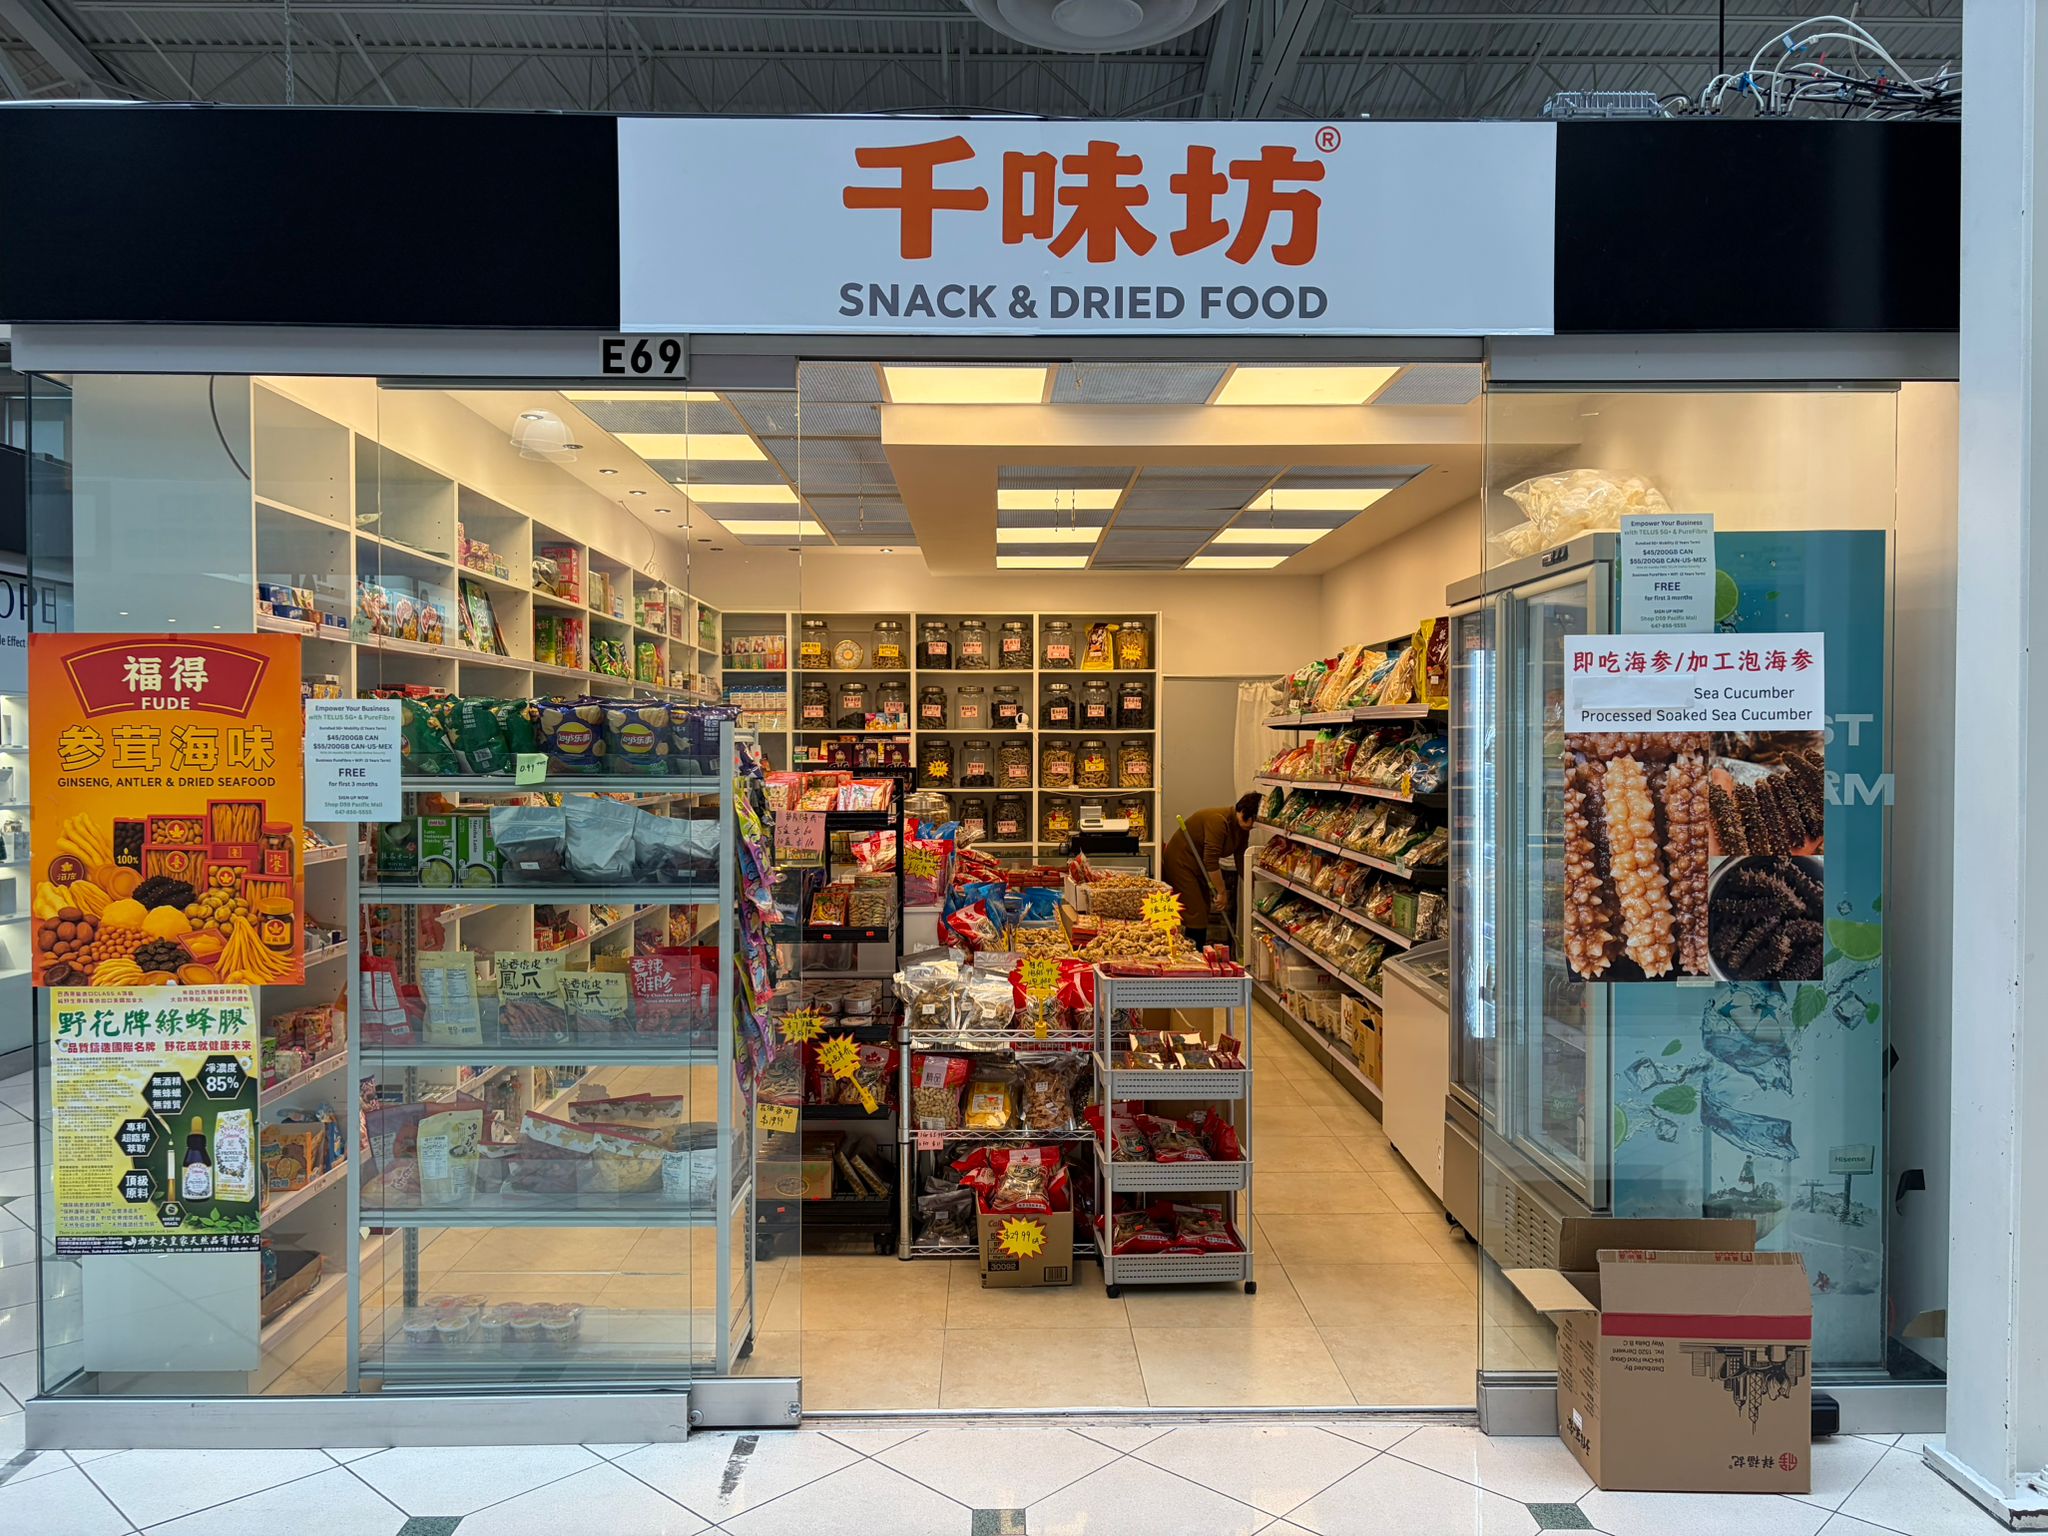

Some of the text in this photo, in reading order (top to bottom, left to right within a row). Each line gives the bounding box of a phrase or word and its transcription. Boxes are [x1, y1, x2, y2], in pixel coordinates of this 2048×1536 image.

[842, 135, 1326, 266] 千味坊
[838, 282, 1328, 319] SNACK & DRIED FOOD
[603, 338, 682, 374] E69
[1654, 582, 1681, 591] FREE
[7, 635, 26, 648] Effect
[1573, 648, 1814, 674] 即吃海参/加工泡海参
[121, 655, 209, 693] 福得
[1694, 686, 1795, 700] Sea Cucumber
[140, 697, 190, 711] FUDE
[1581, 707, 1813, 723] Processed Soaked Sea Cucumber
[58, 724, 275, 772] 参茸海味
[338, 768, 366, 777] FREE
[57, 777, 276, 789] GINSENG, ANTLER & DRIED SEAFOOD
[117, 855, 139, 865] 100%
[58, 1007, 247, 1038] 野花牌綠蜂膠
[206, 1075, 240, 1092] 85%
[990, 1261, 1017, 1271] 30092
[1731, 1455, 1775, 1469] 祥福記
